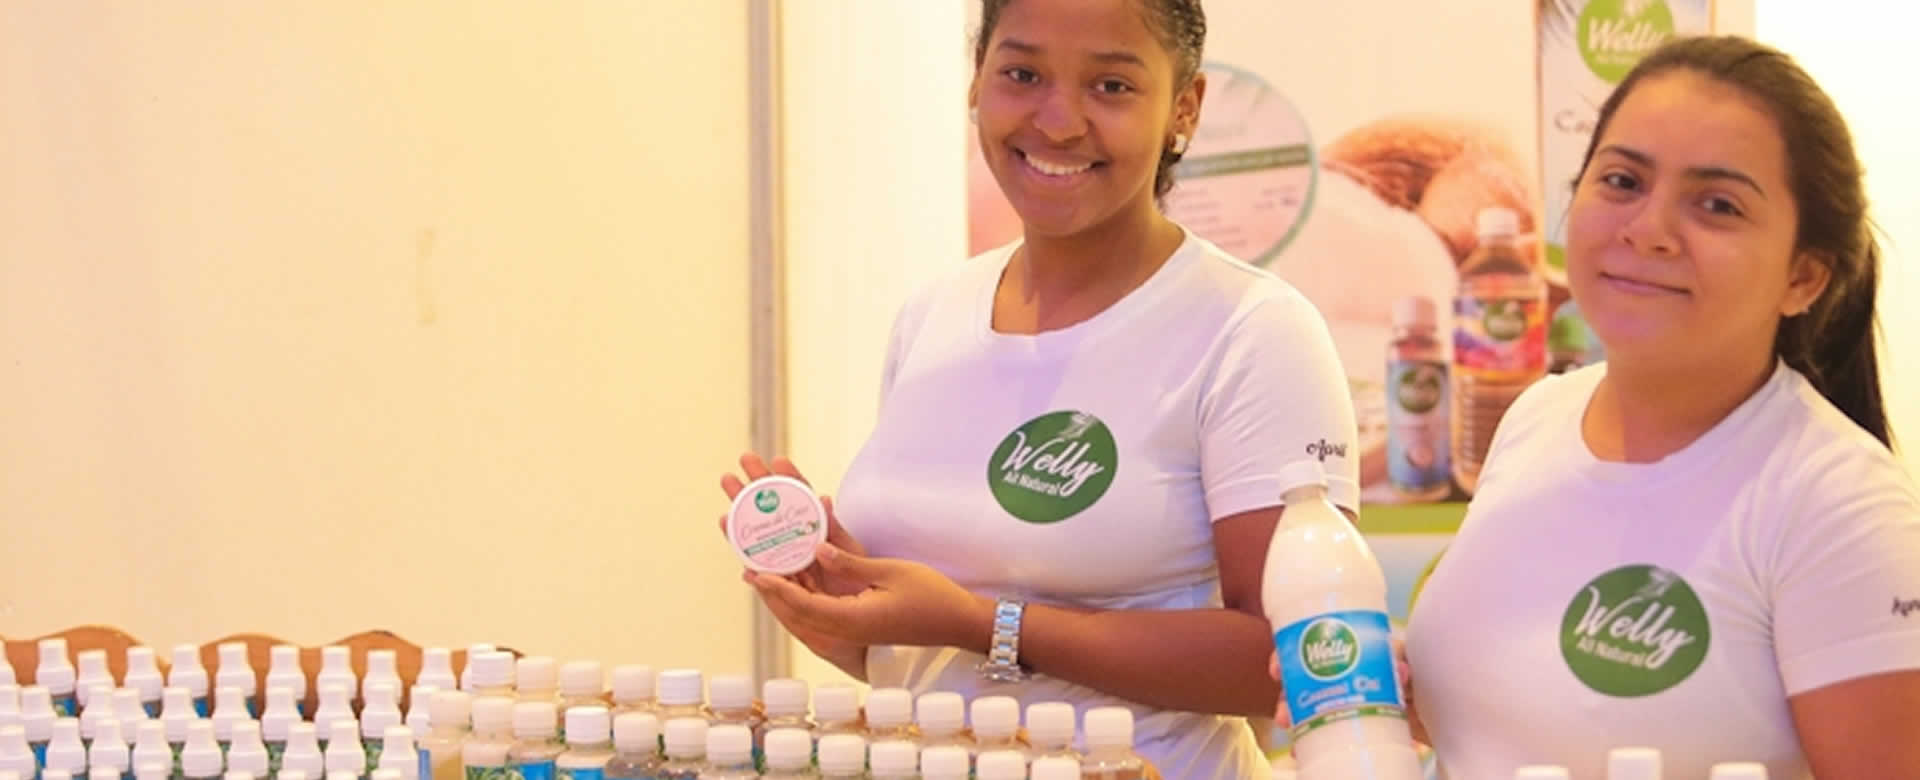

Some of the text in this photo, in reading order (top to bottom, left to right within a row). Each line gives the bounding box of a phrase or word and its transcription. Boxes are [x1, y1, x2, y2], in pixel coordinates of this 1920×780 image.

[1001, 431, 1104, 497] Welly
[1003, 471, 1061, 496] All Natural
[1573, 585, 1697, 670] Welly
[1305, 638, 1353, 663] Welly
[1576, 637, 1649, 668] All Natural
